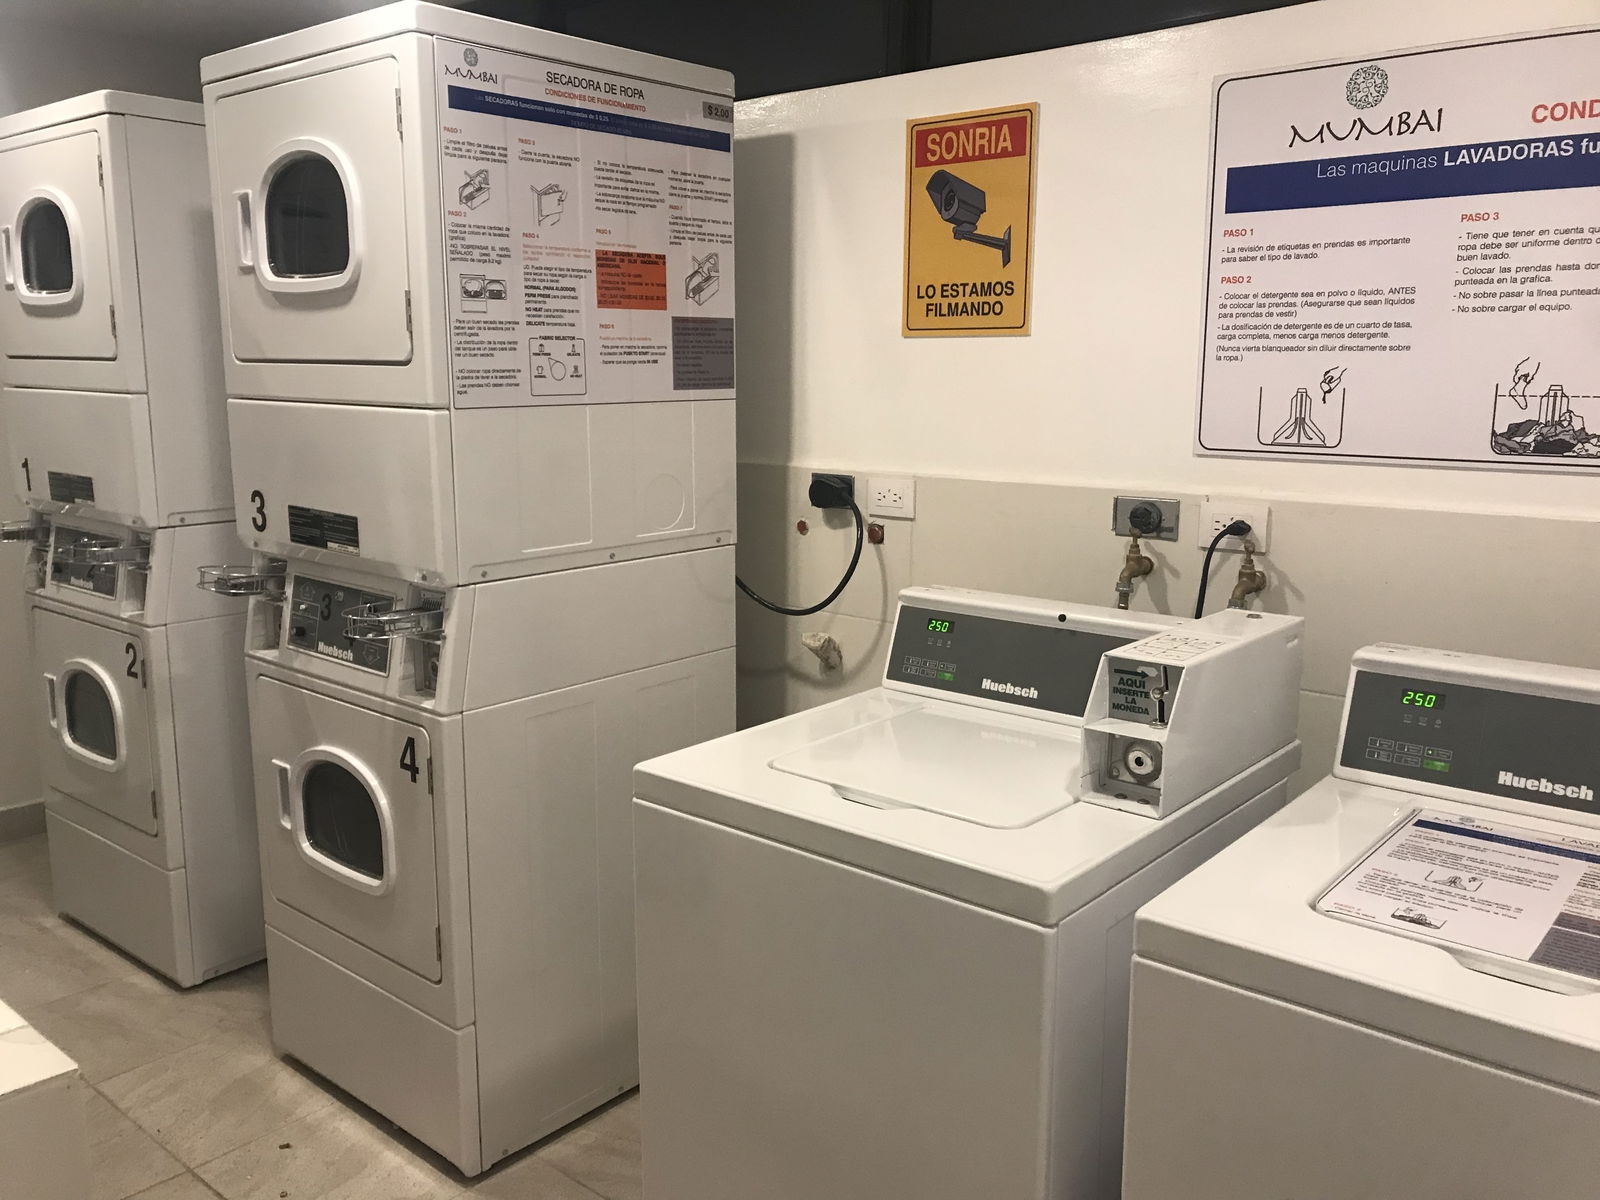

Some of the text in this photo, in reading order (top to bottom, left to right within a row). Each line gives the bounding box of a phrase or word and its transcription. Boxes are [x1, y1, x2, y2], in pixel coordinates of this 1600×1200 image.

[444, 65, 498, 84] MUMBAI
[546, 71, 645, 100] SECADORA DE ROPA
[485, 95, 518, 107] SECADORAS
[545, 88, 646, 112] CONDICIONES DE FUNCIONAMIENTO
[708, 104, 729, 118] $ 2.00
[443, 126, 458, 134] PASO
[1288, 108, 1443, 148] MUMBAI
[927, 124, 1013, 162] SONRIA
[1317, 162, 1346, 179] Las
[1351, 154, 1437, 176] maquinas
[1443, 140, 1574, 167] LAVADORAS
[1460, 212, 1500, 222] PASO 3
[1223, 229, 1247, 238] PASO
[1466, 232, 1489, 240] Tiene
[1492, 231, 1509, 240] que
[1512, 229, 1535, 238] tener
[1553, 226, 1585, 235] cuenta
[1227, 246, 1236, 254] La
[1237, 245, 1264, 253] revisión
[1266, 244, 1275, 252] de
[1277, 242, 1310, 252] etiquetas
[1323, 240, 1355, 250] prendas
[1369, 237, 1411, 247] importante
[1457, 244, 1477, 253] ropa
[1480, 242, 1502, 250] debe
[1505, 241, 1519, 249] ser
[1521, 238, 1560, 248] uniforme
[1563, 237, 1592, 246] dentro
[1221, 252, 1320, 264] para saber el tipo de lavado.
[1456, 251, 1511, 262] buen lavado.
[1462, 266, 1496, 276] Colocar
[1499, 265, 1512, 274] las
[1515, 264, 1552, 274] prendas
[1555, 263, 1581, 271] hasta
[1220, 275, 1252, 284] PASO 2
[1454, 274, 1553, 287] punteada en la grafica.
[916, 280, 1015, 299] LO ESTAMOS
[1223, 292, 1250, 300] Colocar
[1260, 291, 1299, 300] detergente
[1327, 290, 1348, 298] polvo
[1357, 288, 1386, 296] líquido,
[1388, 286, 1416, 295] ANTES
[1458, 291, 1471, 300] No
[1472, 290, 1498, 299] sobre
[1499, 291, 1524, 300] pasar
[1526, 289, 1534, 297] la
[1536, 289, 1558, 297] línea
[925, 300, 1003, 318] FILMANDO
[1229, 301, 1255, 309] colocar
[1267, 300, 1299, 309] prendas.
[1300, 299, 1345, 309] (Asegurarse
[1347, 300, 1362, 308] que
[1363, 298, 1382, 306] sean
[1384, 297, 1415, 306] líquidos
[1457, 302, 1572, 313] No sobre cargar el equipo.
[1217, 310, 1297, 320] para prendas de vestir)
[1284, 322, 1322, 331] detergente
[1356, 321, 1381, 329] cuarto
[1393, 321, 1413, 329] tasa,
[1216, 333, 1236, 341] carga
[1237, 332, 1271, 341] completa,
[1298, 333, 1319, 341] carga
[1347, 331, 1390, 340] detergente.
[1216, 344, 1411, 353] (Nunca vierta blanqueador sin diluir directamente sobre
[22, 458, 32, 492] 1
[250, 489, 267, 533] 3
[928, 620, 949, 633] 250
[317, 641, 353, 661] Huebsch
[125, 642, 138, 679] 2
[981, 678, 1039, 699] Huebsch
[1118, 677, 1146, 690] AQUI
[1112, 686, 1151, 699] INSERTE
[1125, 696, 1137, 705] LA
[1402, 691, 1436, 708] 250
[1112, 702, 1150, 715] MONEDA
[400, 736, 420, 784] 4
[1497, 770, 1594, 801] Huebsch
